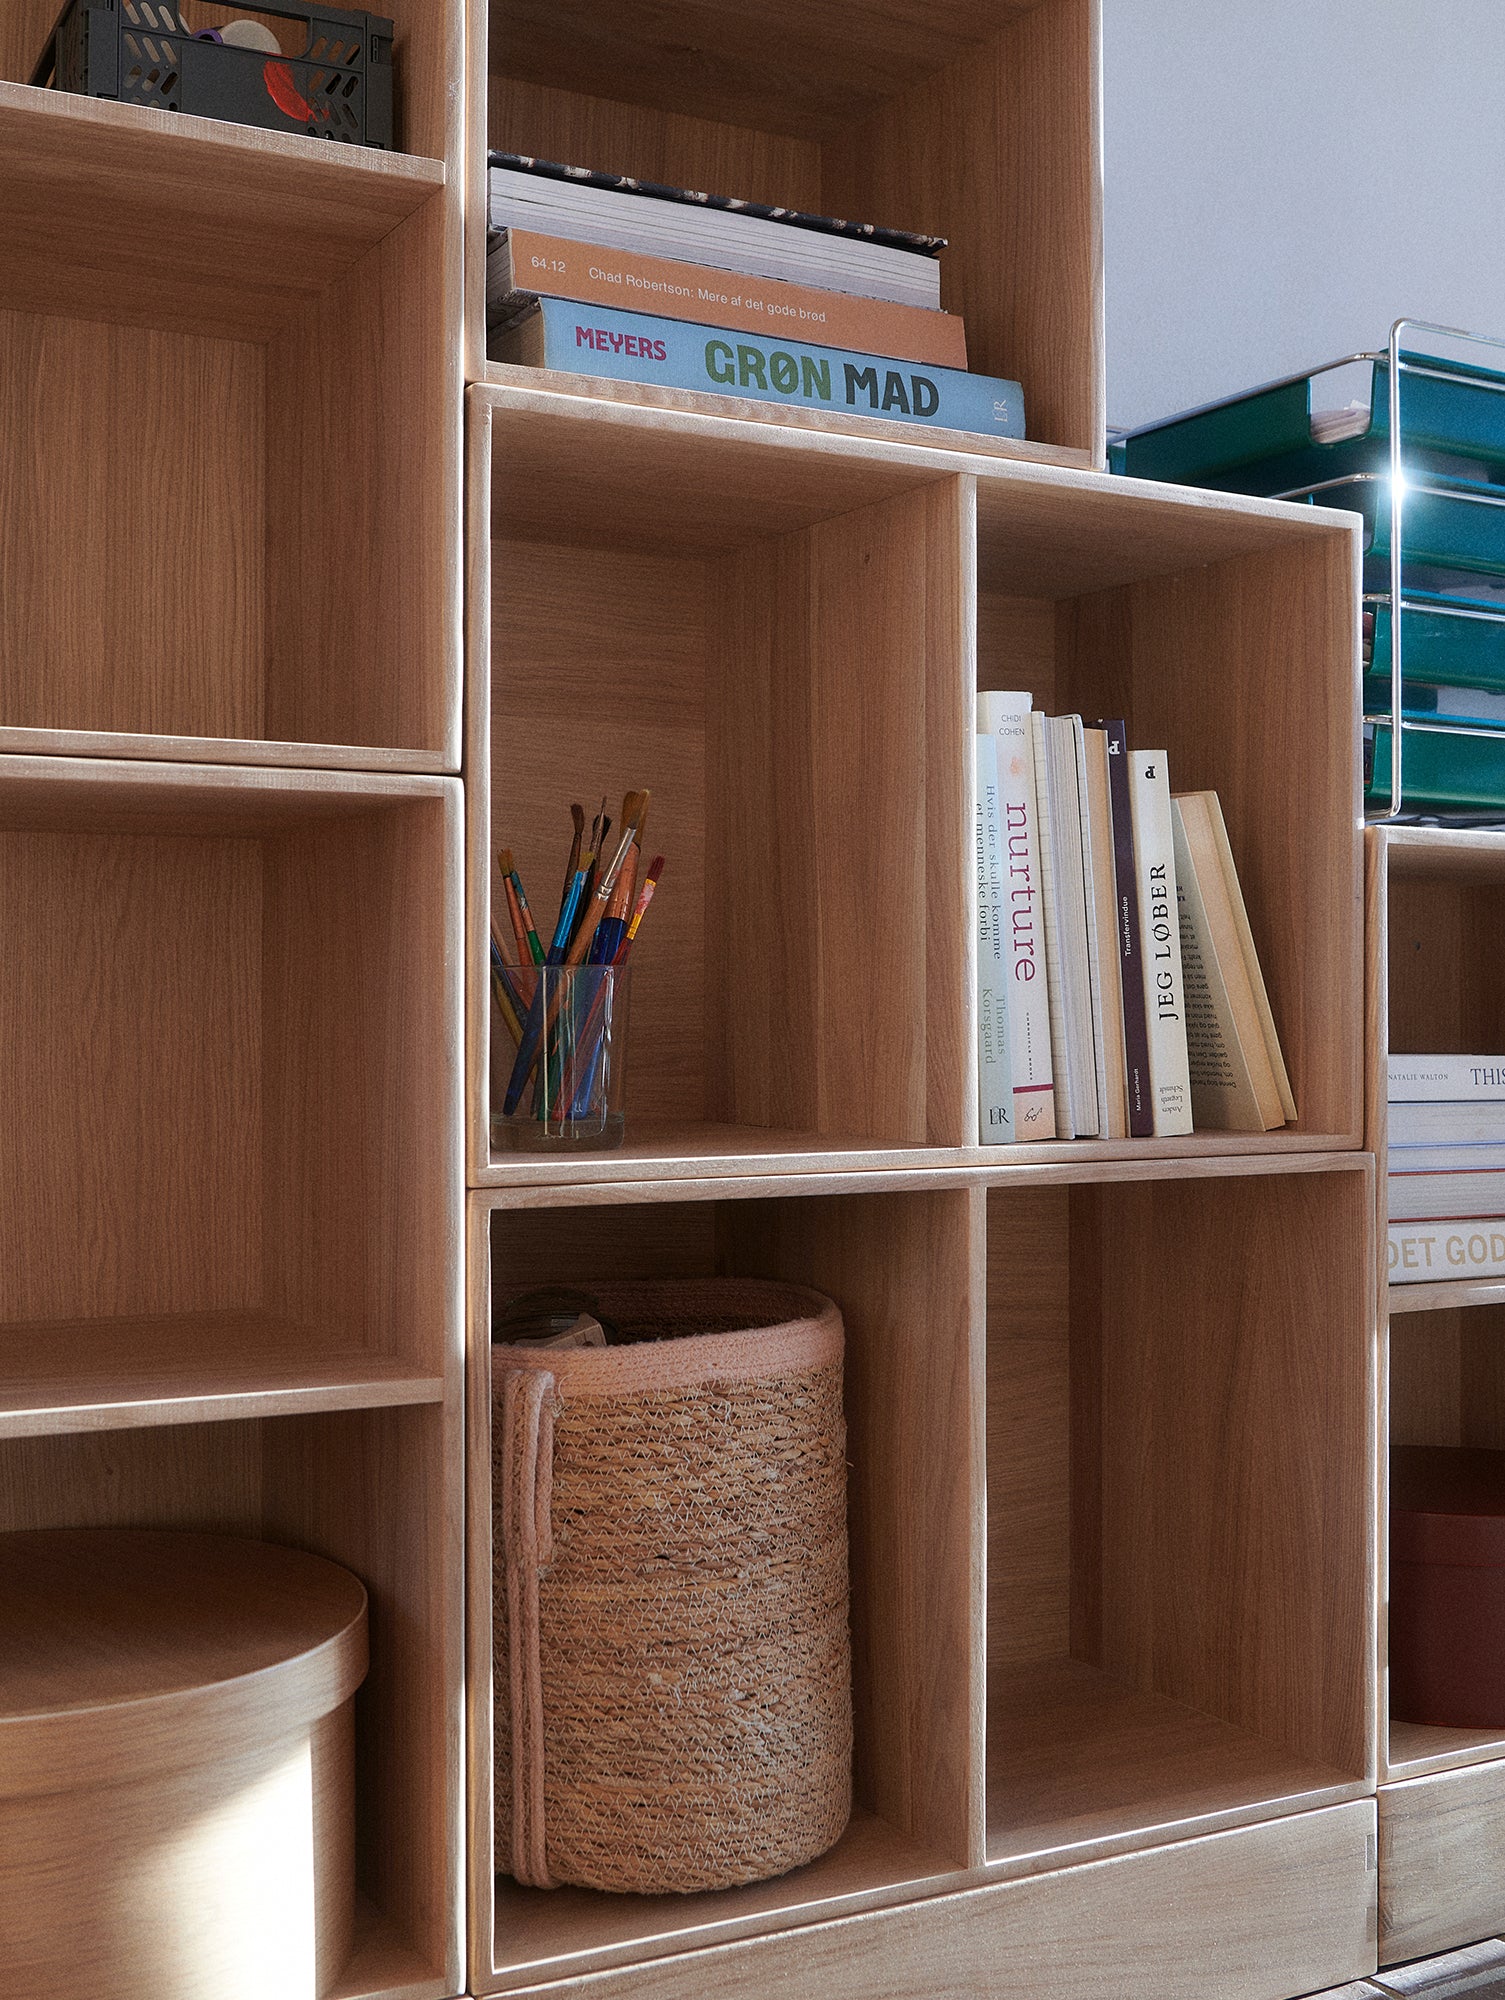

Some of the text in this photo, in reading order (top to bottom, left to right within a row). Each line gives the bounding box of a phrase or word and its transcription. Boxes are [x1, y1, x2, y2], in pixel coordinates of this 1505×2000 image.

[531, 256, 566, 273] 64.12
[588, 266, 826, 323] Chad Robertson: Mere af det gode brød
[575, 325, 667, 361] MEYERS
[704, 339, 940, 417] GRØN MAD
[999, 727, 1026, 736] COHEN
[977, 822, 990, 899] menneske
[986, 785, 1002, 960] Hvis der skulle komme
[979, 904, 991, 942] forbi
[1006, 803, 1037, 982] nurture
[1122, 896, 1131, 957] Transfervindue
[1150, 863, 1179, 1021] JEG LØBER
[980, 988, 997, 1065] Korsgaard
[995, 994, 1007, 1055] Thomas
